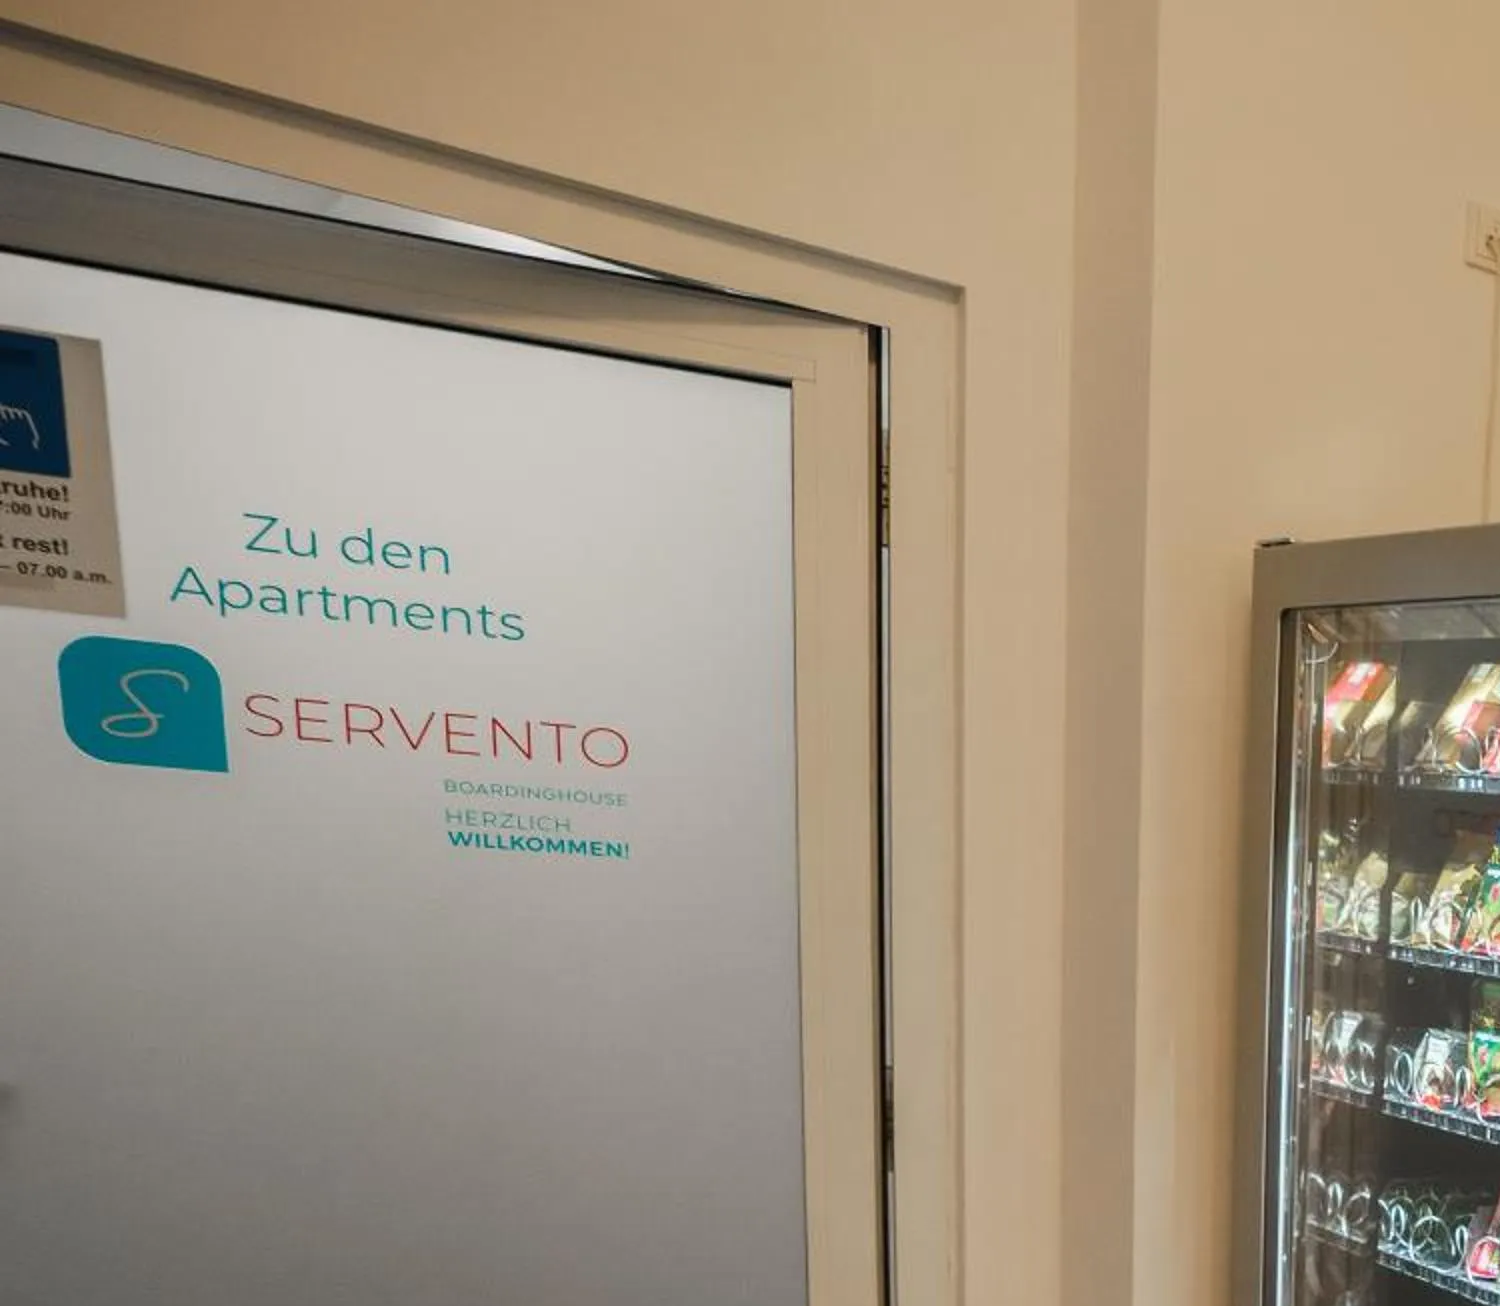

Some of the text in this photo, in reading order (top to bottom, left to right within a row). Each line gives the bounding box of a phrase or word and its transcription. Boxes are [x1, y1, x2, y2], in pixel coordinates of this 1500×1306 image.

[0, 480, 69, 503] ruhe!
[37, 504, 71, 521] Uhr
[12, 535, 69, 557] rest!
[242, 512, 451, 575] Zu den
[17, 560, 68, 580] 07.00
[169, 565, 526, 641] Apartments
[244, 693, 630, 769] SERVENTO
[442, 778, 630, 808] BOARDINGHOUSE
[443, 808, 573, 833] HERZLICH
[447, 830, 631, 860] WILLKOMMEN!
